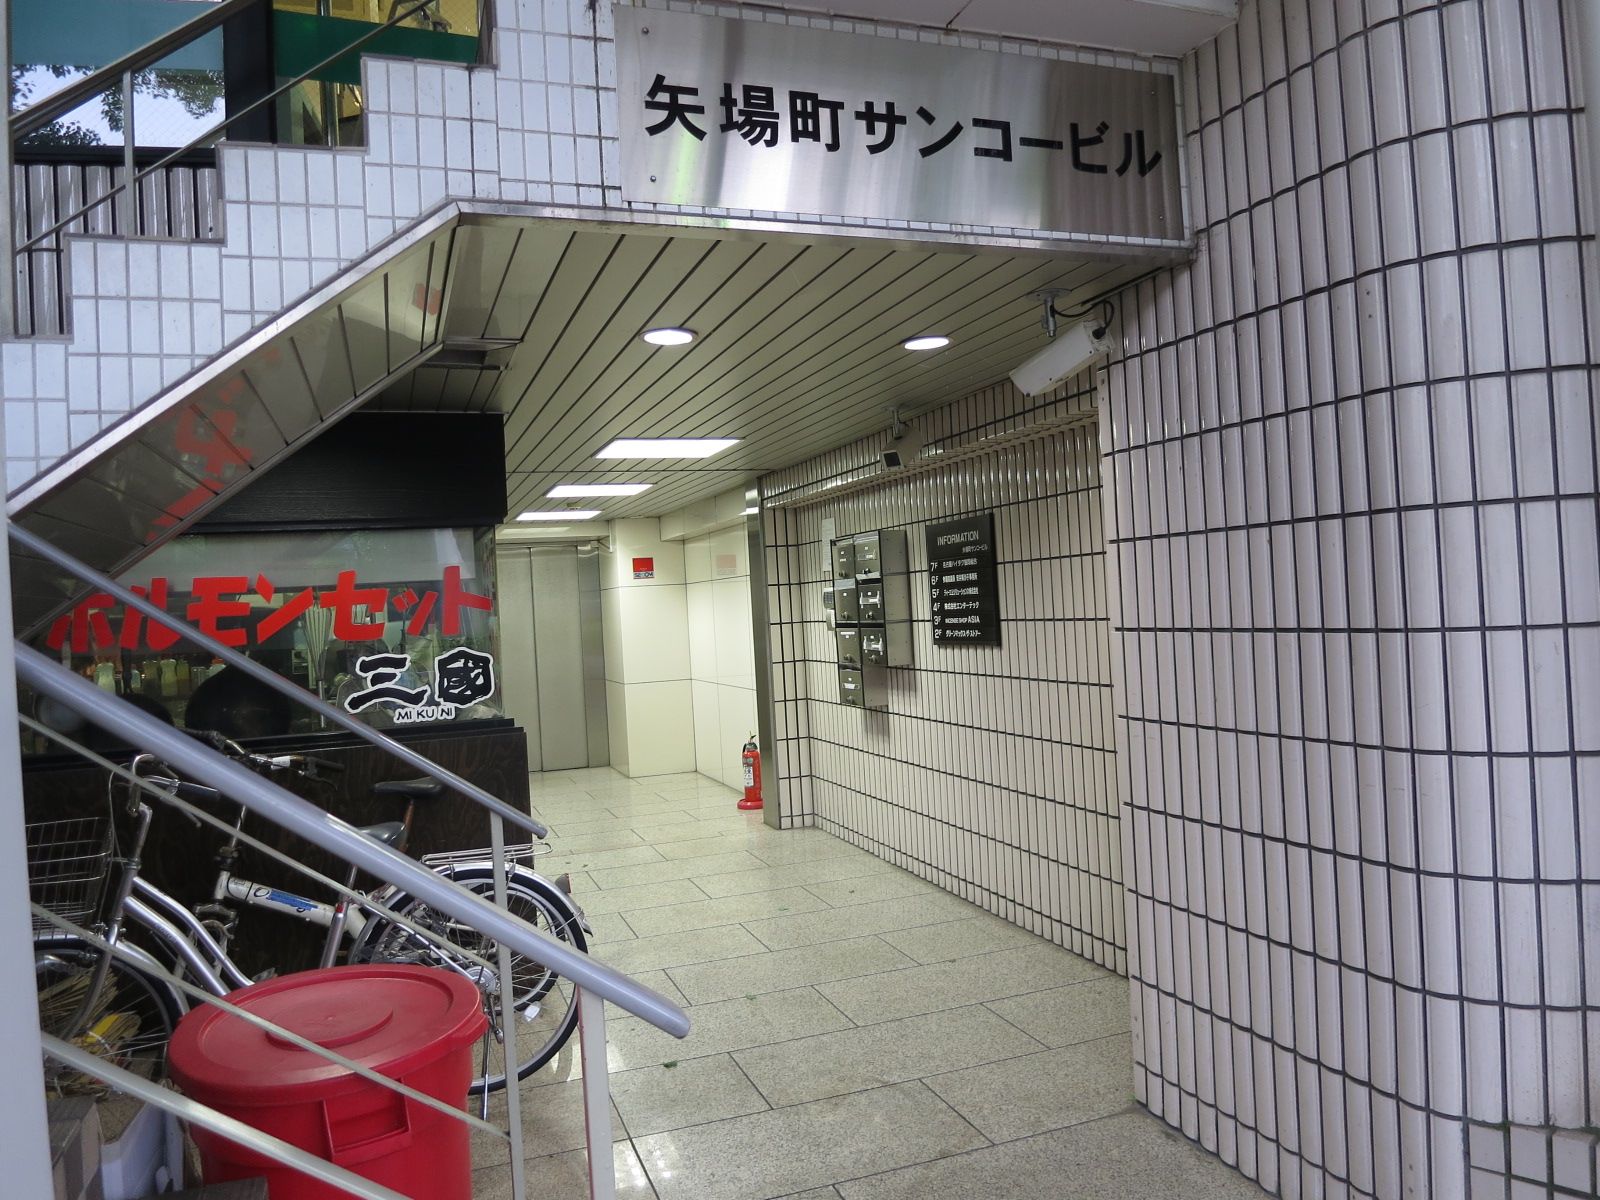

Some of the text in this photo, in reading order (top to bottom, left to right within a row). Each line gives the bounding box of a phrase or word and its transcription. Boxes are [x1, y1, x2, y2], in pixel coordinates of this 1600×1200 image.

[644, 74, 1162, 178] 矢場町サンコービル
[937, 530, 979, 546] INFORMATION
[46, 566, 492, 654] ホルモンセット
[968, 615, 980, 623] ASIA
[344, 647, 495, 714] 三國
